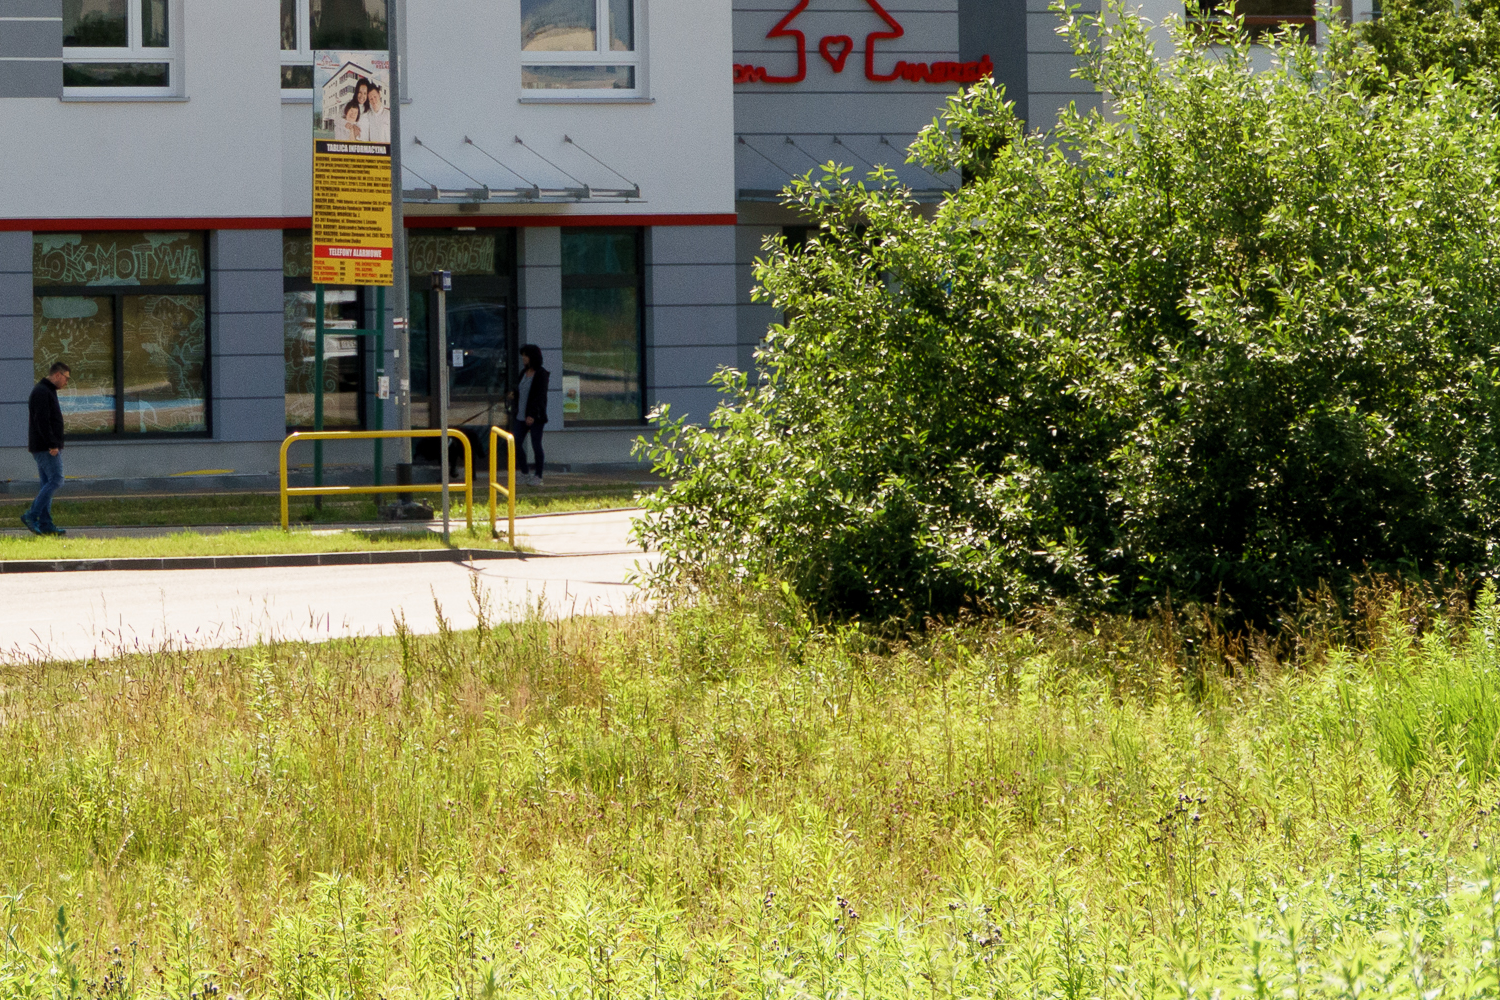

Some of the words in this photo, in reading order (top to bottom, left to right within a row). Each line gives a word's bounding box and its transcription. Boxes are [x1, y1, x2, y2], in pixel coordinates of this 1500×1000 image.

[326, 143, 348, 153] TABLICA
[348, 144, 387, 155] INFORMACYJNA
[328, 247, 353, 257] TELEFONY
[352, 248, 382, 258] ALARMOWE
[33, 242, 202, 282] LOKOMOTYWA
